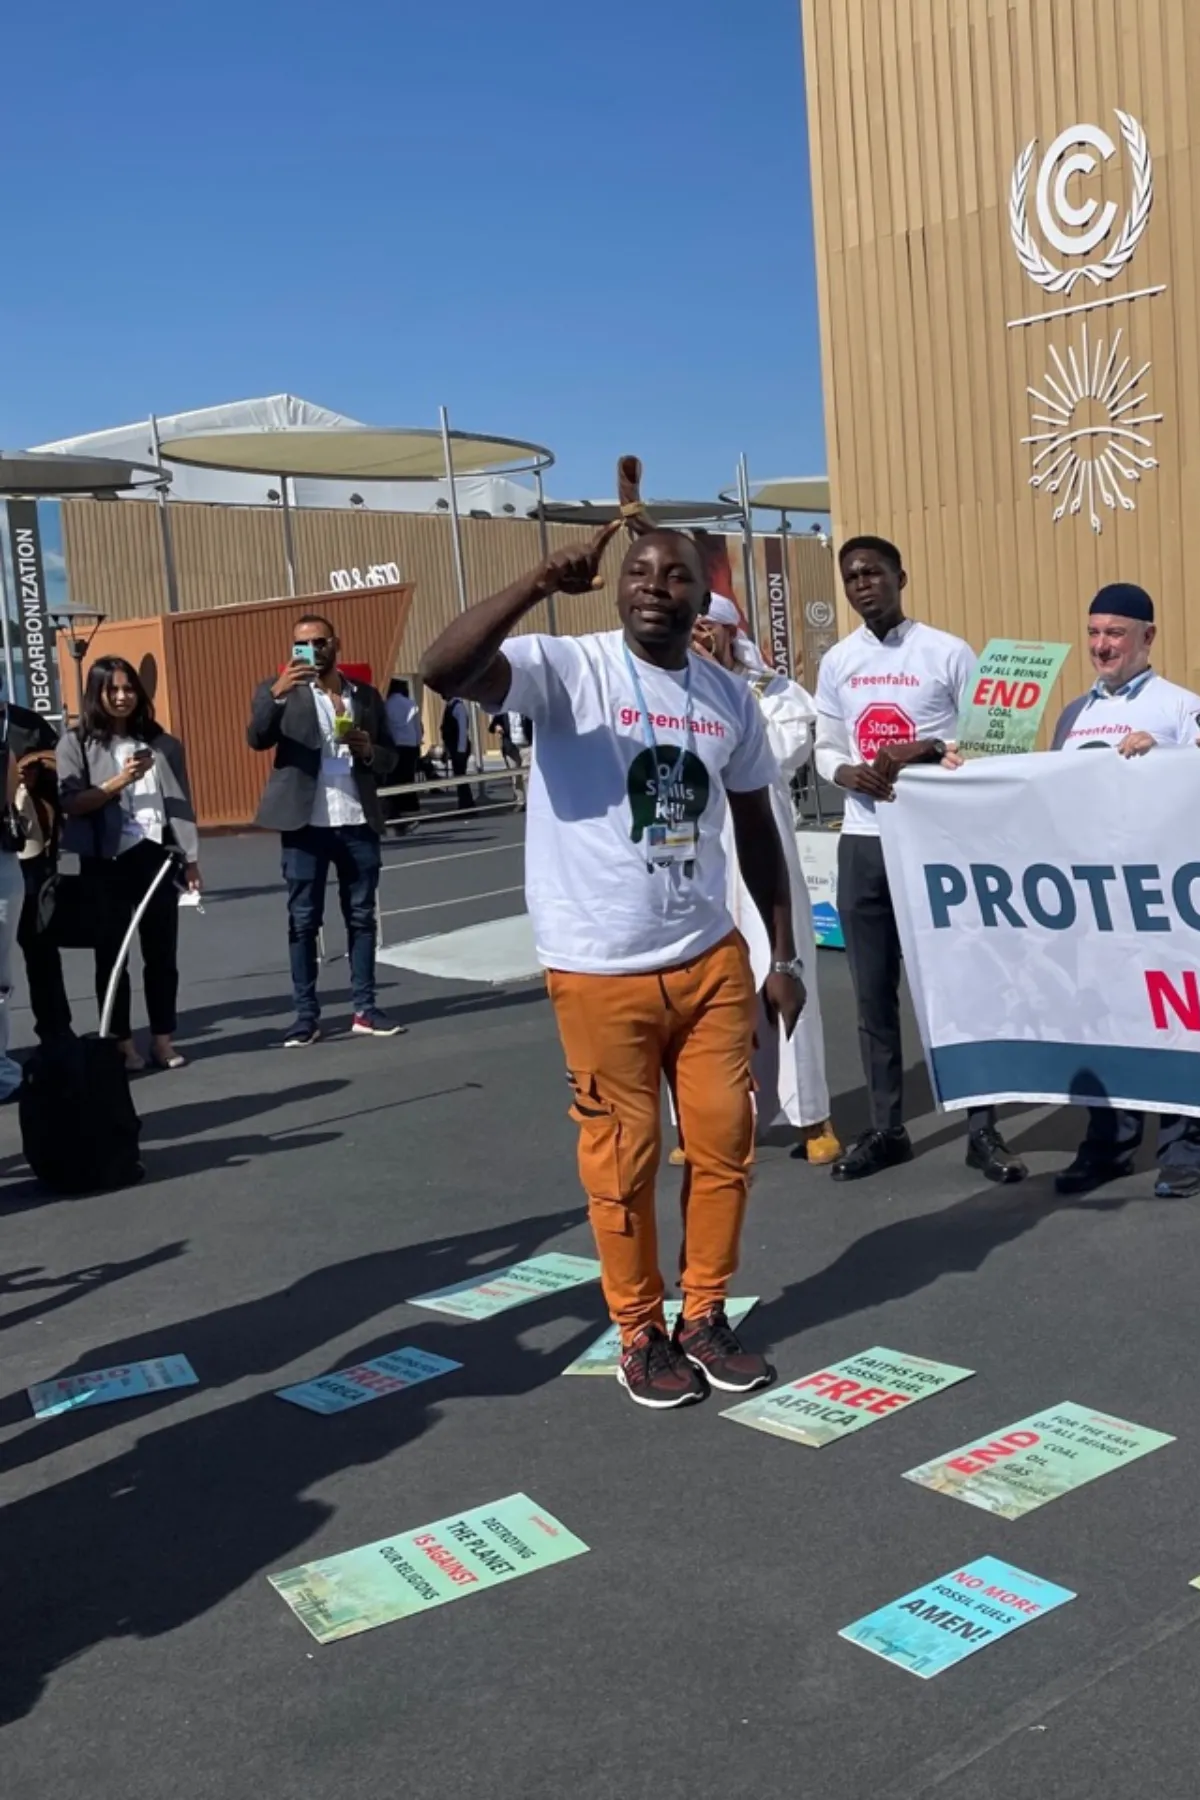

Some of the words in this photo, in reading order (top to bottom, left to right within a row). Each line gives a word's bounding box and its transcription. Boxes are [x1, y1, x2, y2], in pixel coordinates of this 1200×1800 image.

[16, 528, 51, 713] DECARBONIZATION
[768, 573, 788, 677] DAPTATION
[980, 665, 993, 674] OF
[994, 667, 1011, 676] ALL
[1013, 669, 1048, 679] BEINGS
[989, 654, 1009, 663] FOR
[1010, 655, 1029, 665] THE
[1028, 657, 1054, 666] SAKE
[850, 672, 920, 689] greenfaith
[973, 678, 1041, 711] END
[621, 707, 725, 738] greenfaith
[868, 720, 899, 736] Stop
[988, 707, 1012, 718] COAL
[990, 719, 1005, 729] OIL
[986, 729, 1005, 739] GAS
[838, 1365, 886, 1385] FOSSIL
[887, 1378, 925, 1394] FUEL
[853, 1356, 910, 1377] FAITHS
[912, 1371, 946, 1387] FOR
[793, 1372, 914, 1415] FREE
[766, 1394, 861, 1427] AFRICA
[1033, 1421, 1053, 1433] OF
[1052, 1427, 1076, 1442] ALL
[1076, 1436, 1128, 1457] BEINGS
[1051, 1415, 1079, 1428] FOR
[1080, 1424, 1104, 1436] THE
[1106, 1433, 1141, 1449] SAKE
[946, 1430, 1040, 1475] END
[1025, 1454, 1049, 1467] OIL
[1043, 1444, 1079, 1459] COAL
[1003, 1463, 1034, 1477] GAS
[412, 1533, 436, 1546] IS
[446, 1520, 478, 1541] THE
[464, 1538, 516, 1575] PLANET
[481, 1516, 536, 1559] DESTROYING
[379, 1546, 404, 1564] OUR
[393, 1561, 440, 1600] RELIGIONS
[422, 1545, 479, 1586] AGAINST
[931, 1584, 974, 1608] FOSSIL
[973, 1602, 1017, 1625] FUELS
[951, 1572, 984, 1589] NO
[983, 1585, 1043, 1614] MORE
[899, 1598, 993, 1643] AMEN!
